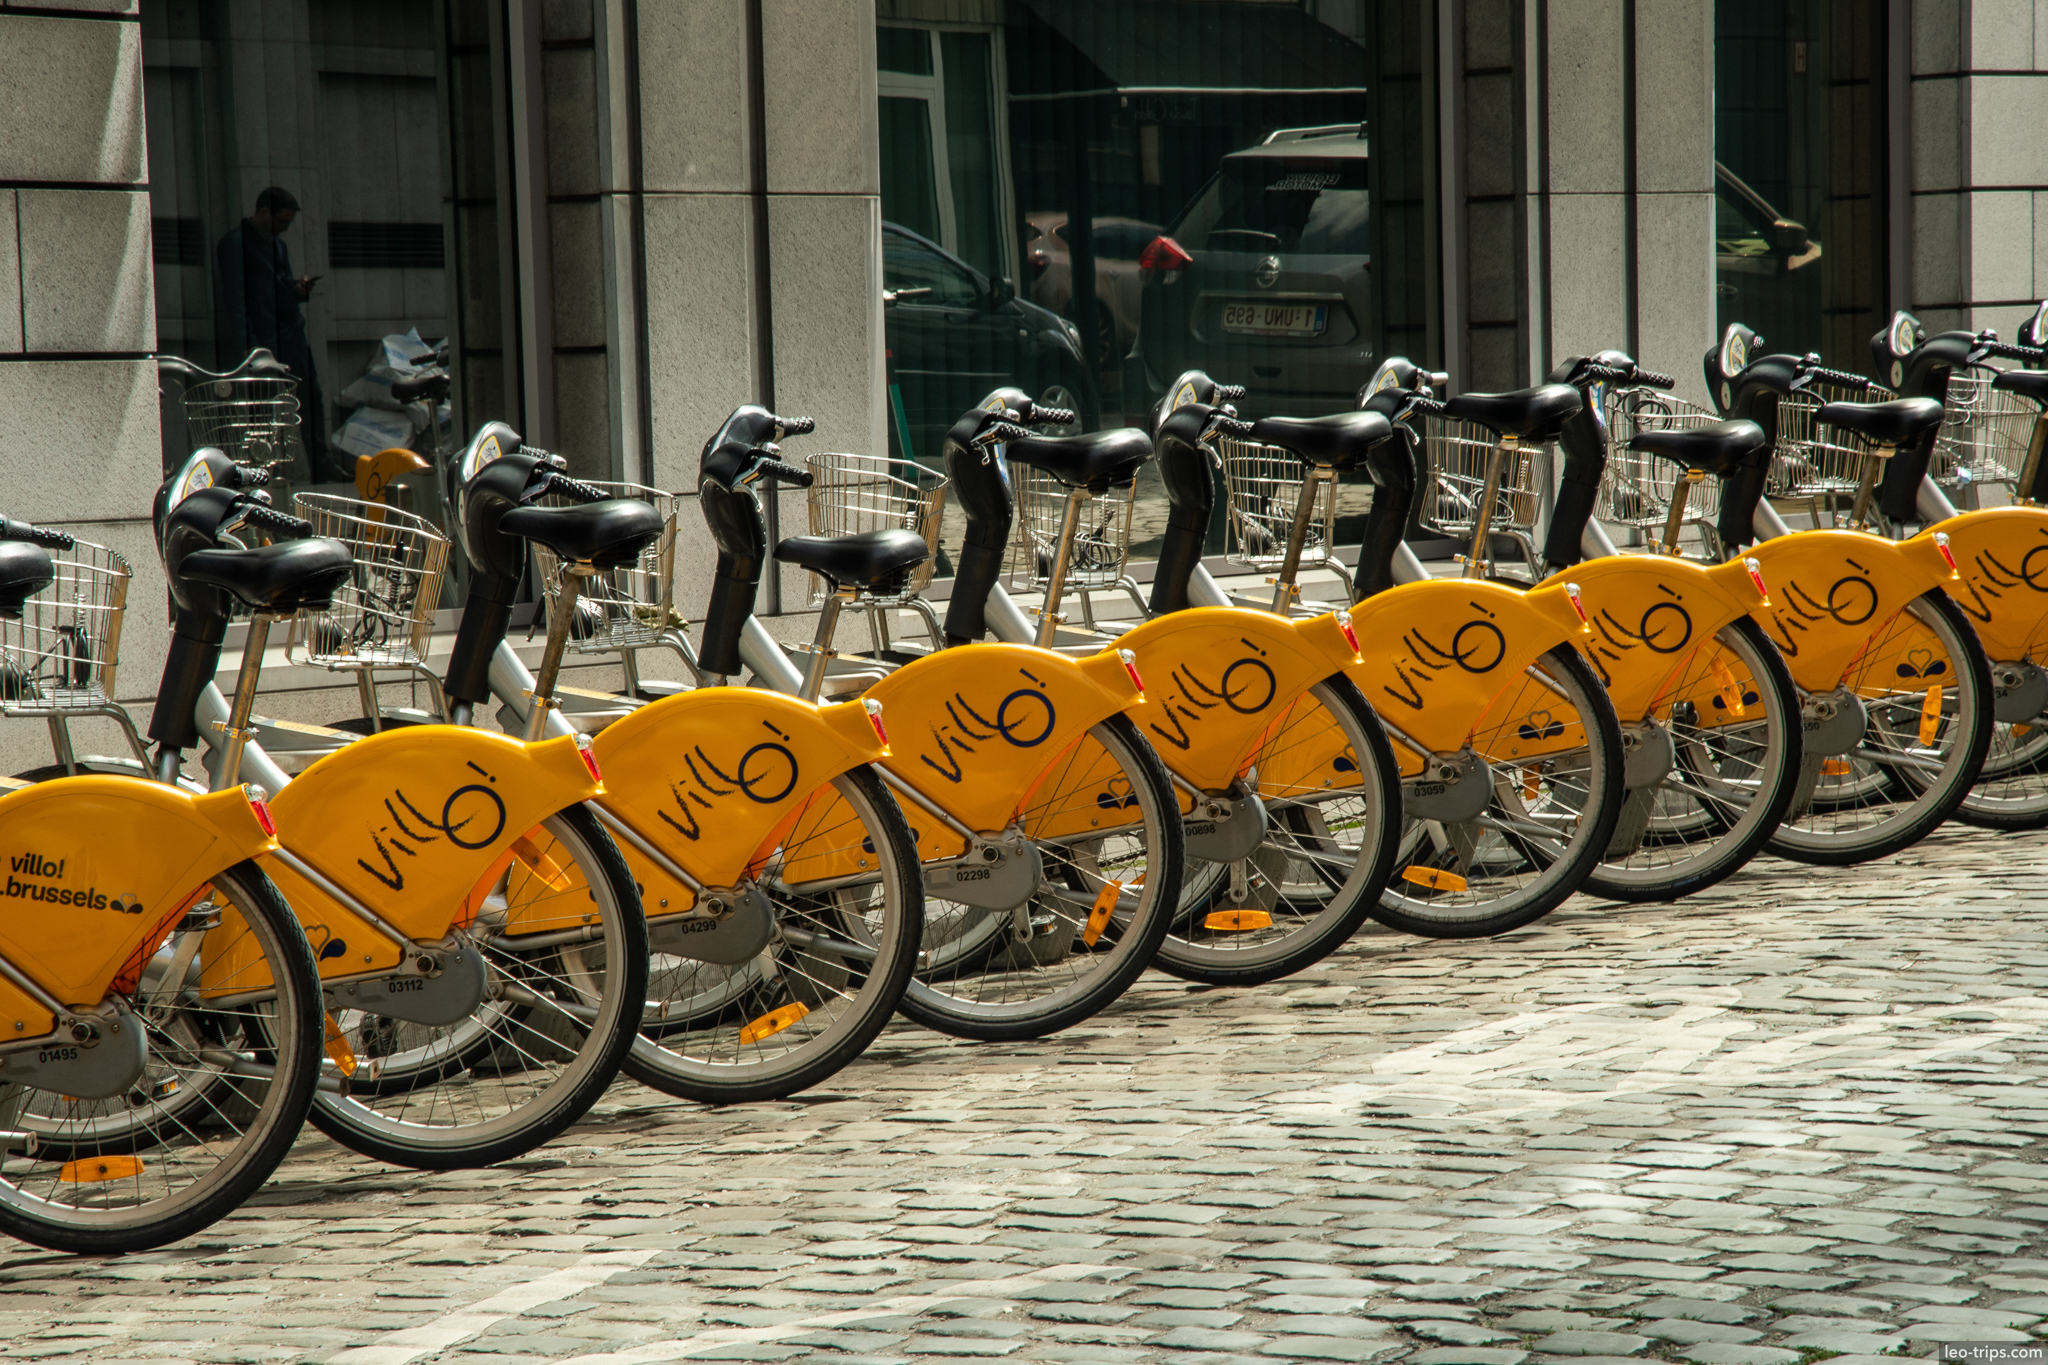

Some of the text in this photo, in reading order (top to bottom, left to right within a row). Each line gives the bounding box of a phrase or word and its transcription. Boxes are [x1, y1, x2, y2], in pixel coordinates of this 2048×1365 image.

[1414, 785, 1445, 797] 03059
[1185, 824, 1216, 837] 00898
[11, 852, 65, 879] villo!
[956, 869, 991, 882] 02298
[0, 875, 108, 911] .brussels
[682, 920, 717, 934] 04299
[389, 979, 424, 993] 03112
[39, 1048, 78, 1064] 01495
